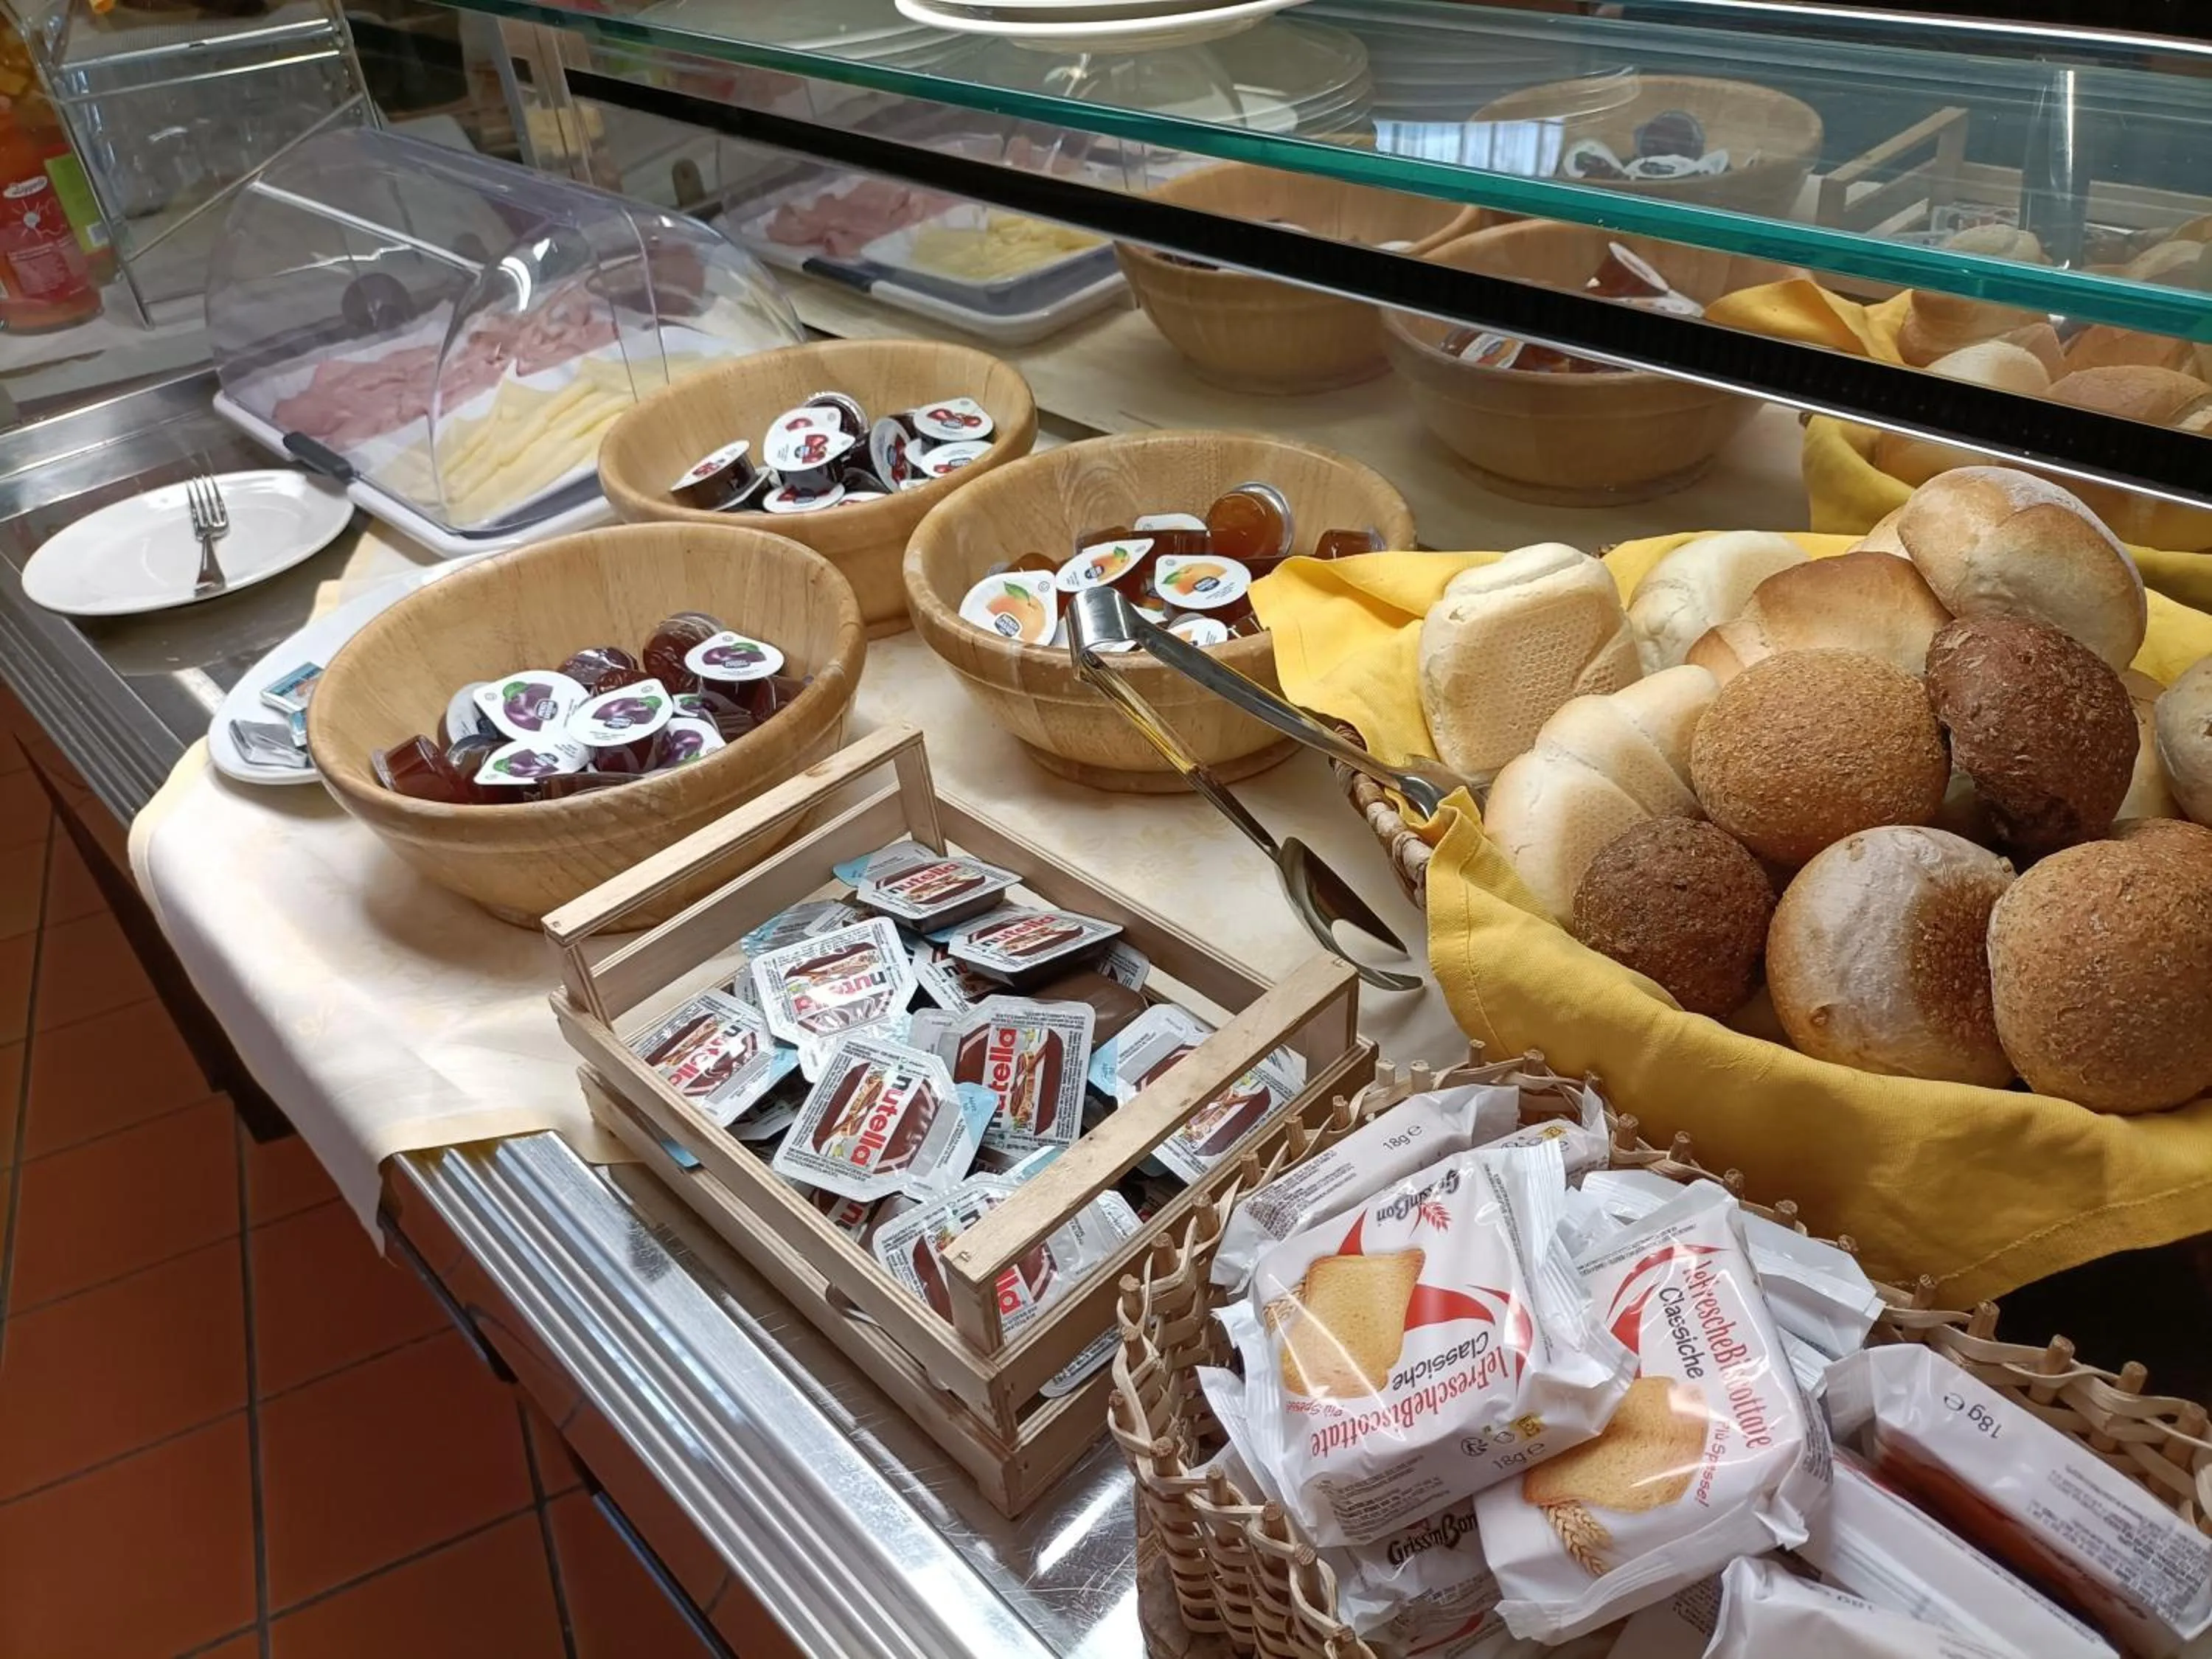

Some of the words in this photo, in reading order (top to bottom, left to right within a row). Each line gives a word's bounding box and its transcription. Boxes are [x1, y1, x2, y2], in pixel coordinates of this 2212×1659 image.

[888, 863, 960, 894] nutella
[981, 915, 1057, 946] nutella
[849, 1074, 913, 1165] nutella
[1382, 1133, 1411, 1151] 18g
[1659, 1287, 1704, 1380] Classiche
[1391, 1331, 1490, 1391] Classiche
[1311, 1346, 1508, 1457] leFrescheBiscottate
[1968, 1403, 2002, 1439] 18g
[1492, 1452, 1527, 1470] 18g
